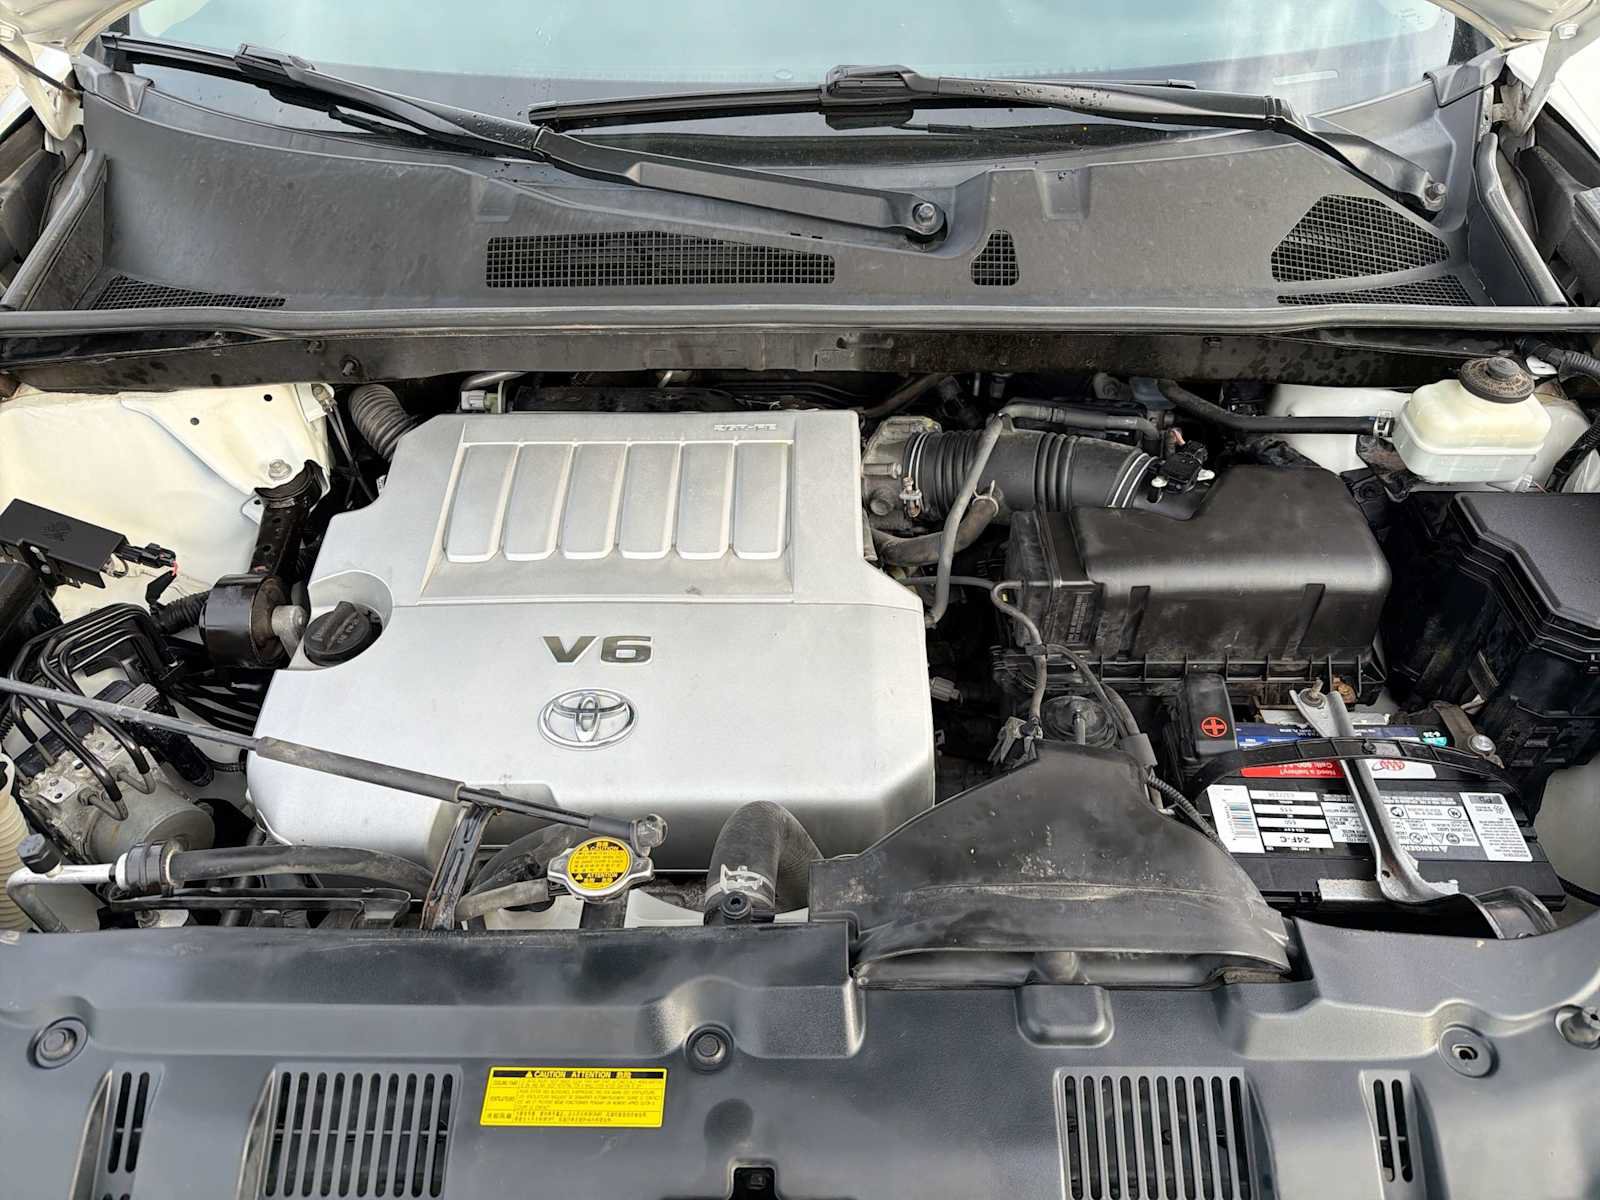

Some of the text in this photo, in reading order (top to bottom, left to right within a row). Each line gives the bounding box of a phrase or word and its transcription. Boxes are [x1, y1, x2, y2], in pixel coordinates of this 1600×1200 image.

[542, 635, 653, 663] V6
[1279, 835, 1311, 844] 24F-C
[533, 1070, 566, 1079] CAUTION
[571, 1071, 612, 1079] ATTENTION
